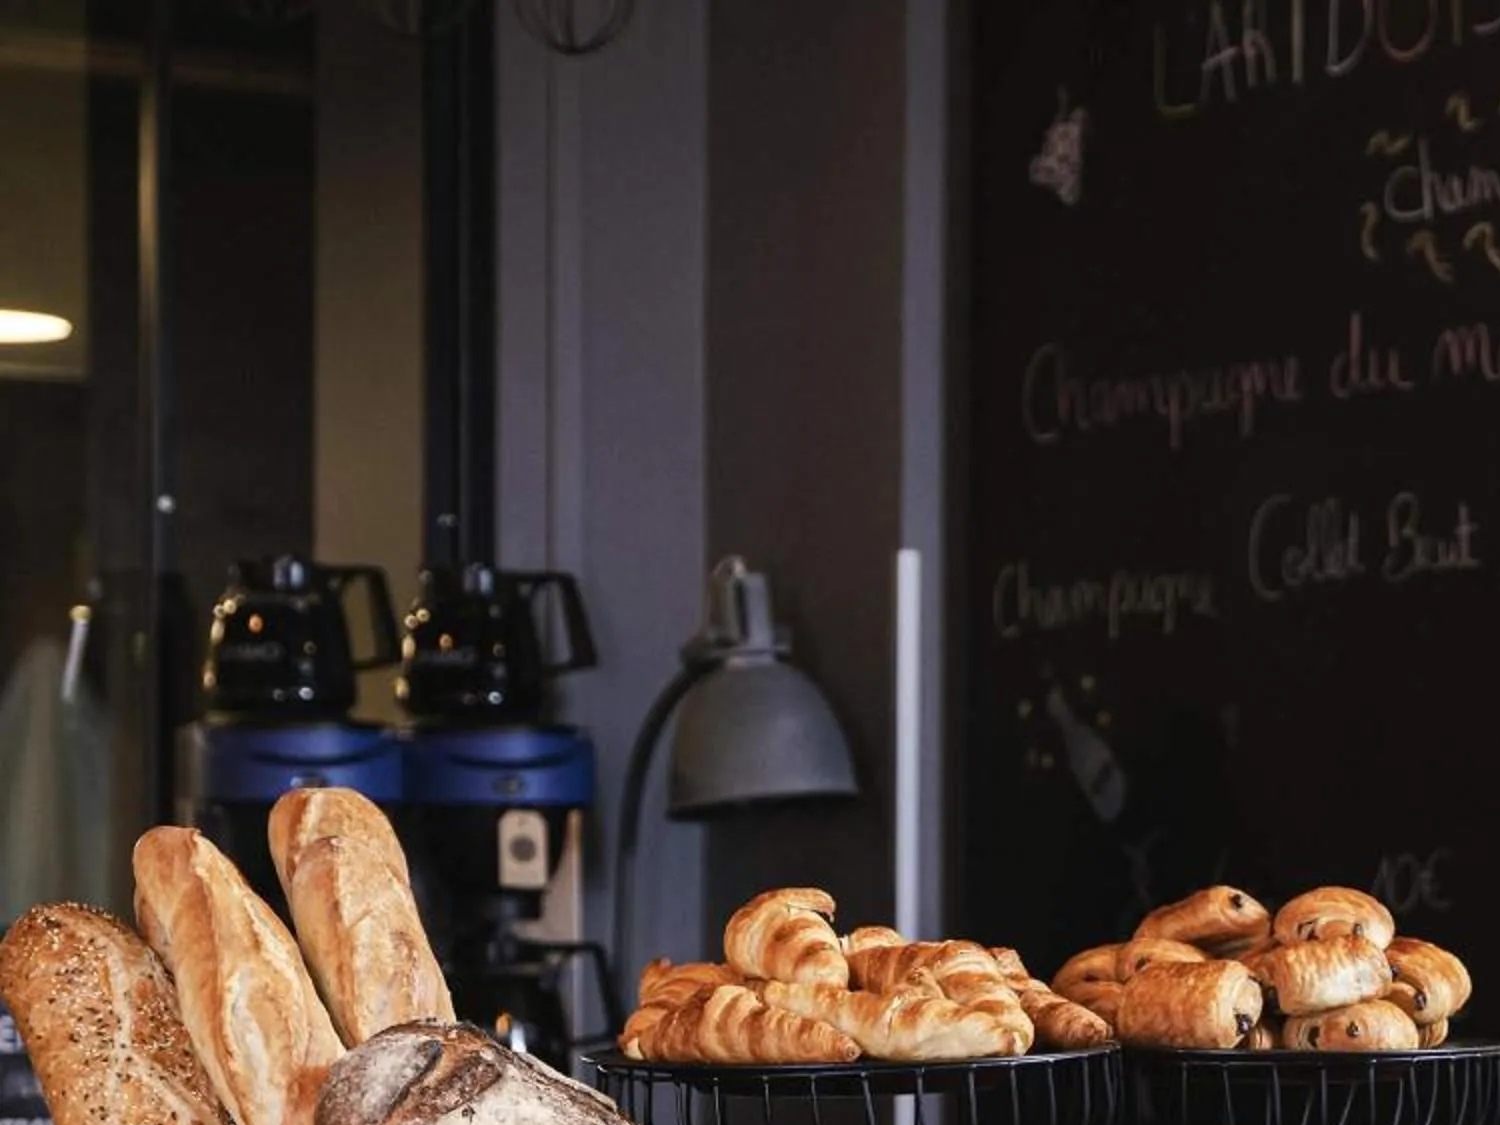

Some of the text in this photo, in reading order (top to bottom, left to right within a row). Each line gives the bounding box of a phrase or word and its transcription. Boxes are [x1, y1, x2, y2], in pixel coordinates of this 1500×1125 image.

[1021, 343, 1302, 450] Champagne
[1330, 310, 1414, 400] du
[992, 562, 1218, 639] Champagne
